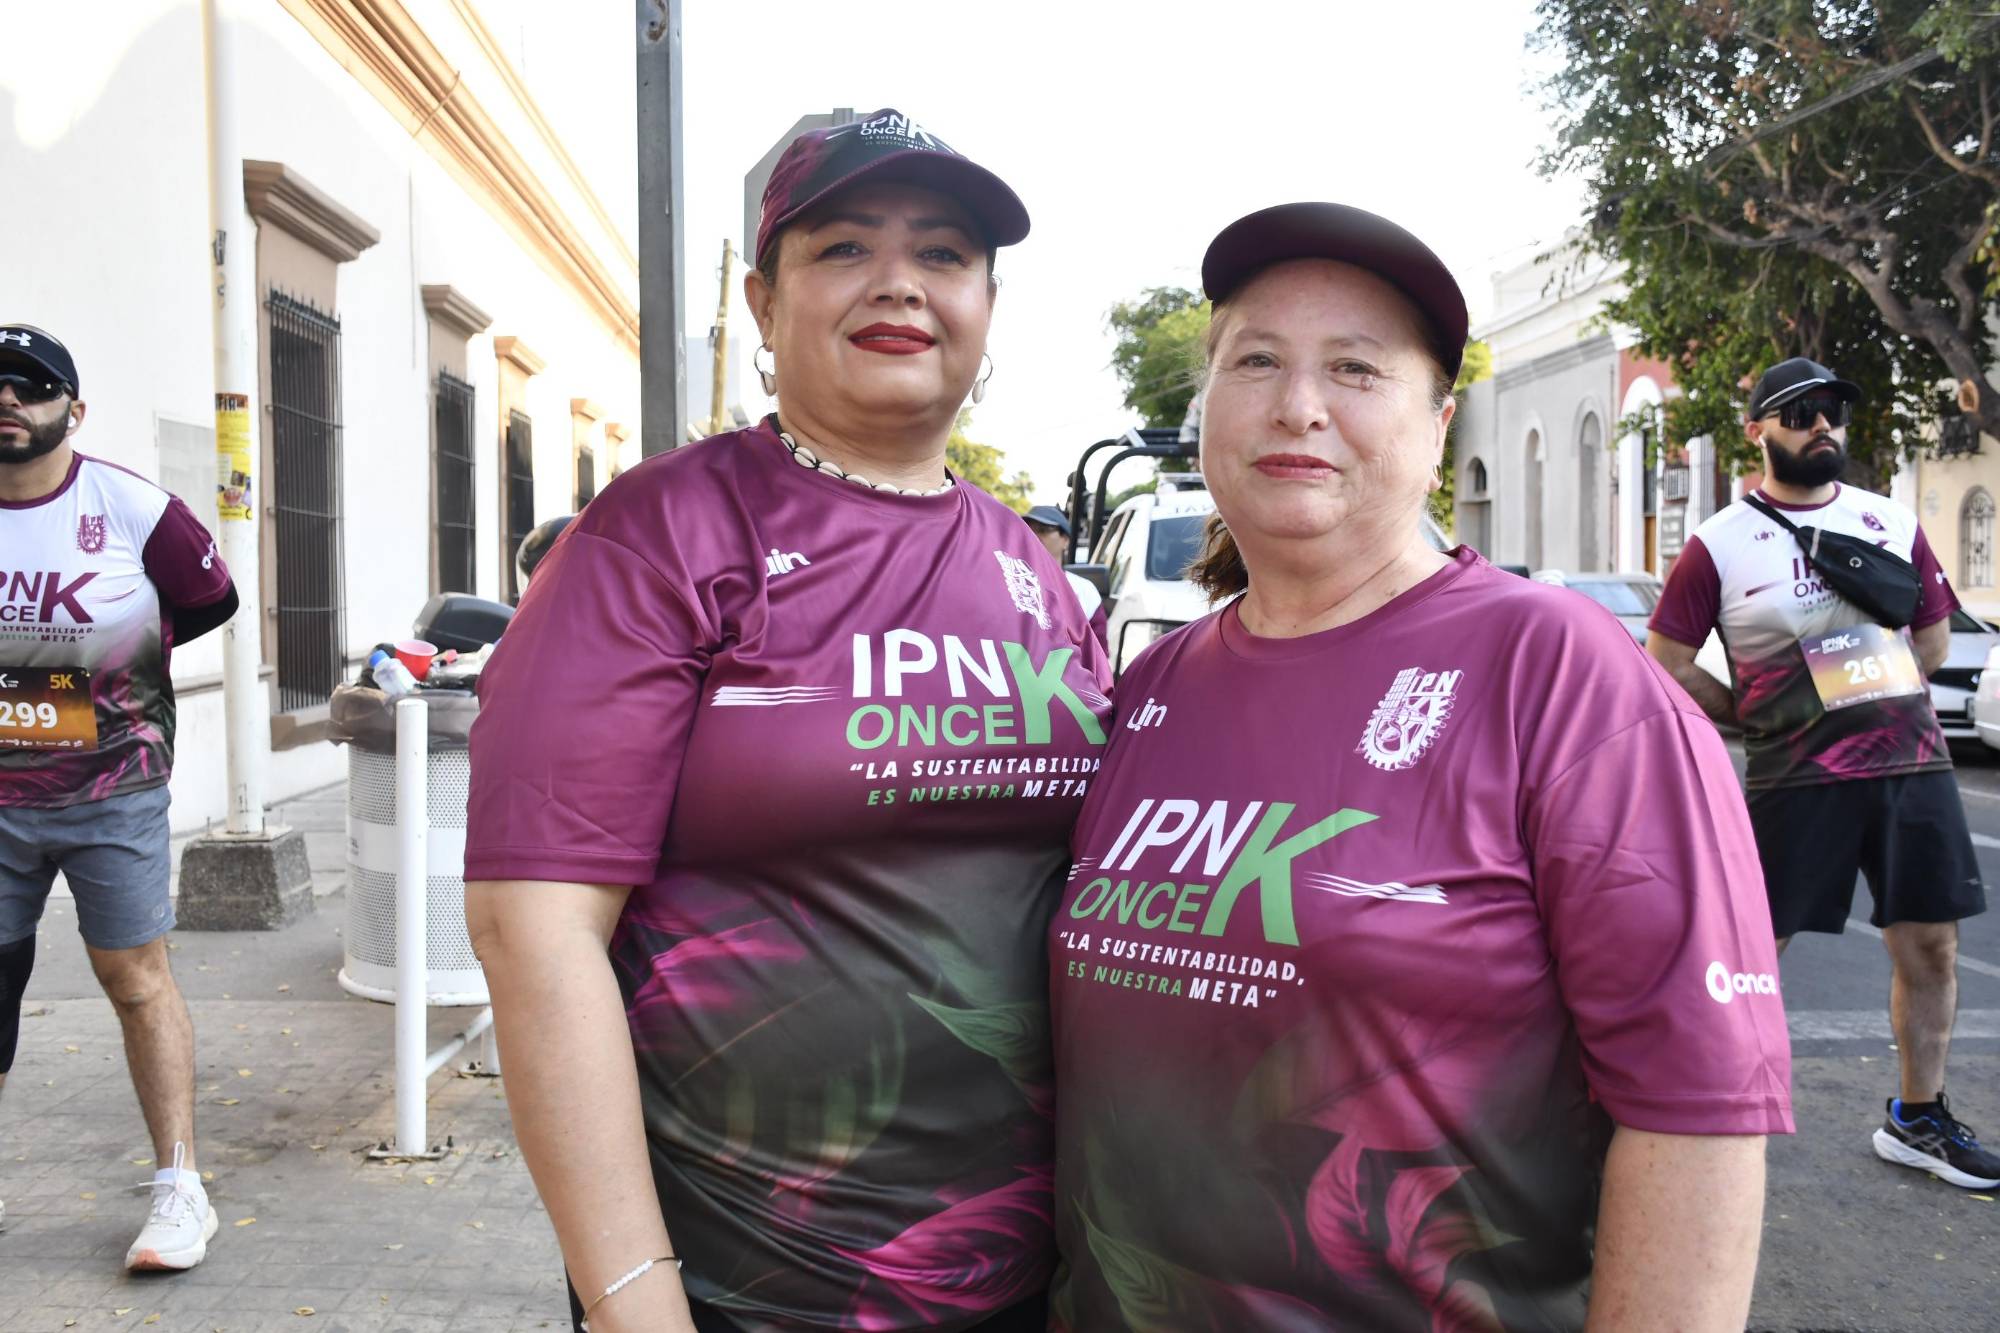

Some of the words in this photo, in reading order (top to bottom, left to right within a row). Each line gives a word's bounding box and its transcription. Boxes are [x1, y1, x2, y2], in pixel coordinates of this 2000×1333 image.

[860, 127, 906, 137] ONCE
[50, 673, 76, 689] 5K
[1406, 669, 1463, 695] IPN
[845, 704, 1018, 750] ONCE
[867, 788, 897, 806] ES
[908, 783, 1016, 803] NUESTRA
[1069, 877, 1210, 934] ONCE
[1099, 937, 1306, 987] SUSTENTABILIDAD,
[1067, 960, 1087, 979] ES
[1093, 965, 1183, 996] NUESTRA
